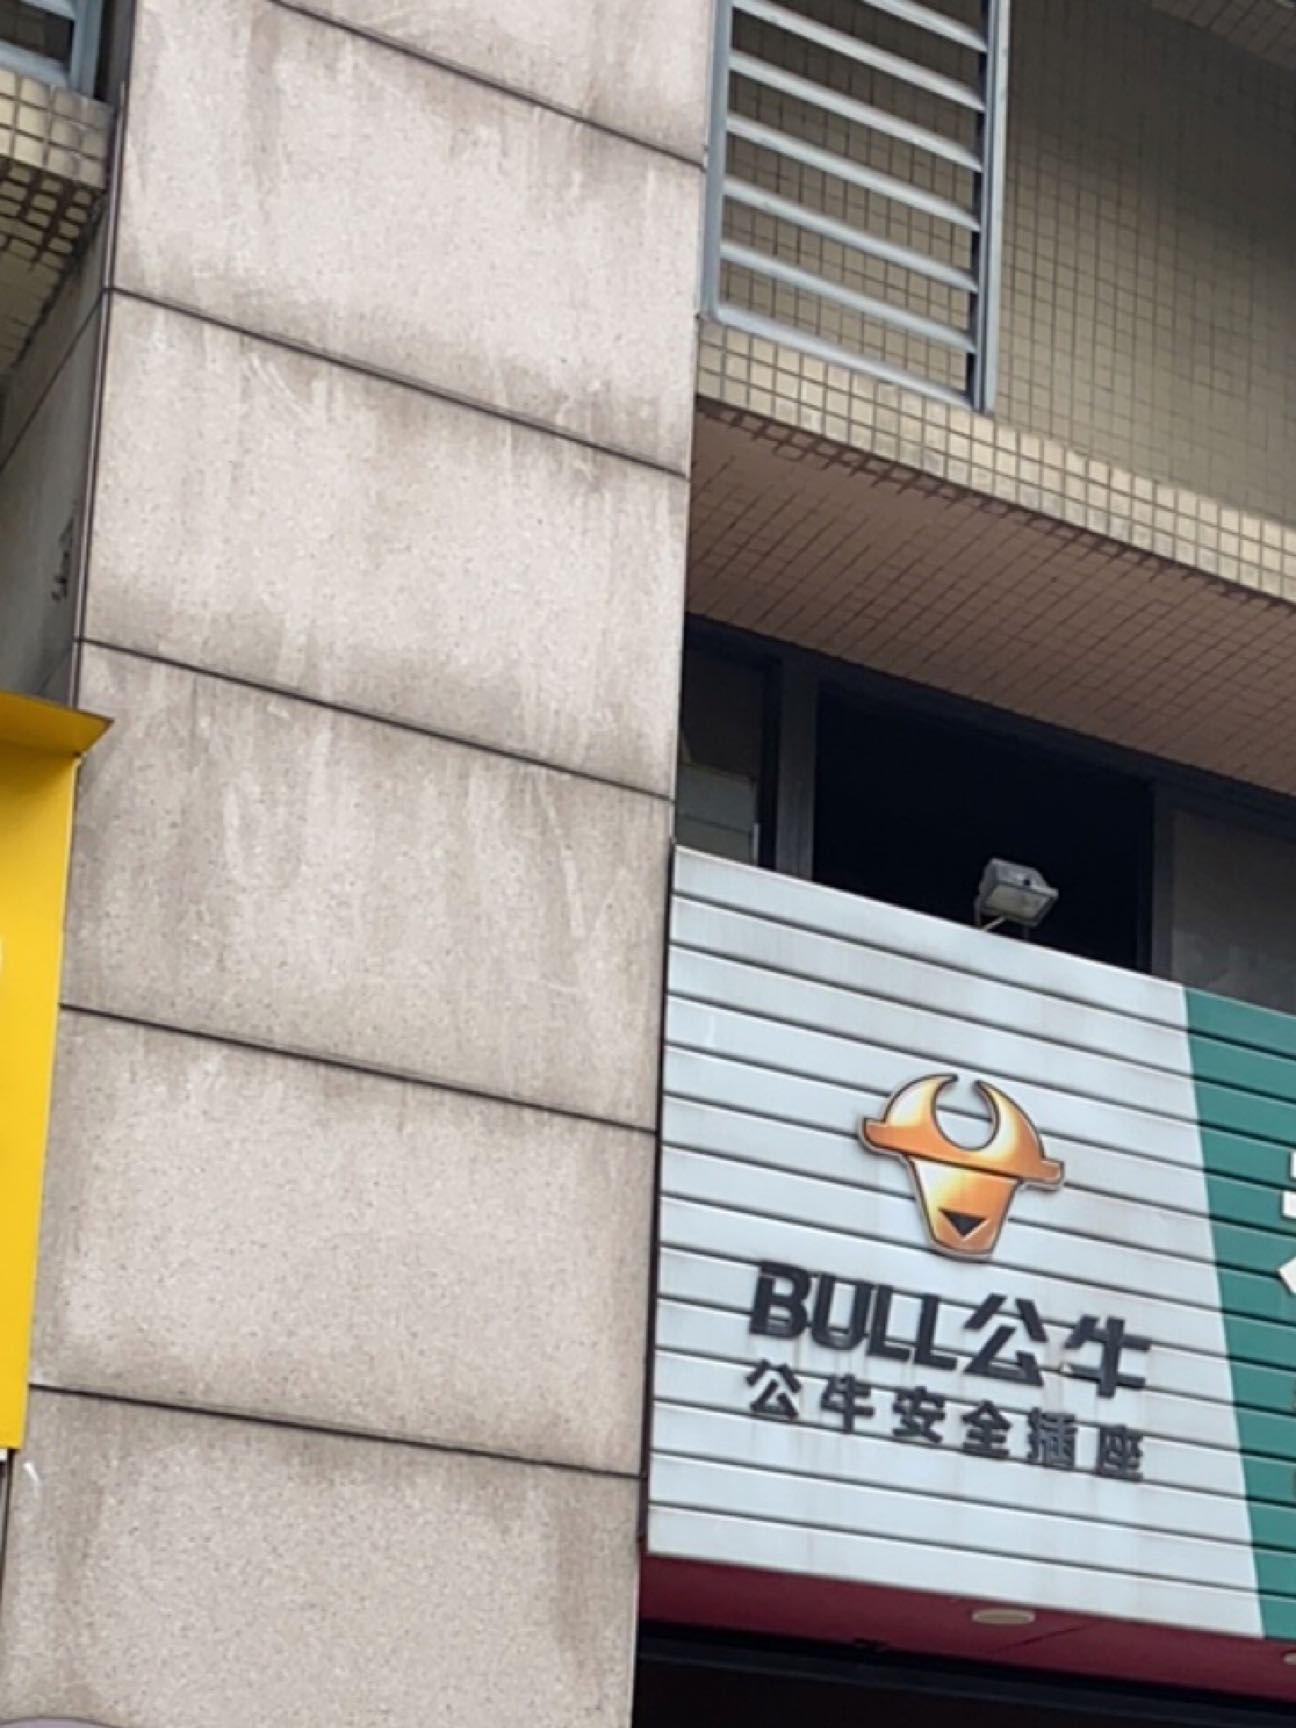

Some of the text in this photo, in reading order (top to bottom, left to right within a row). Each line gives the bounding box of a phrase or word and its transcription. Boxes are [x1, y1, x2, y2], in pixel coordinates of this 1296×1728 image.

[744, 1359, 1147, 1483] 公牛安全插座
